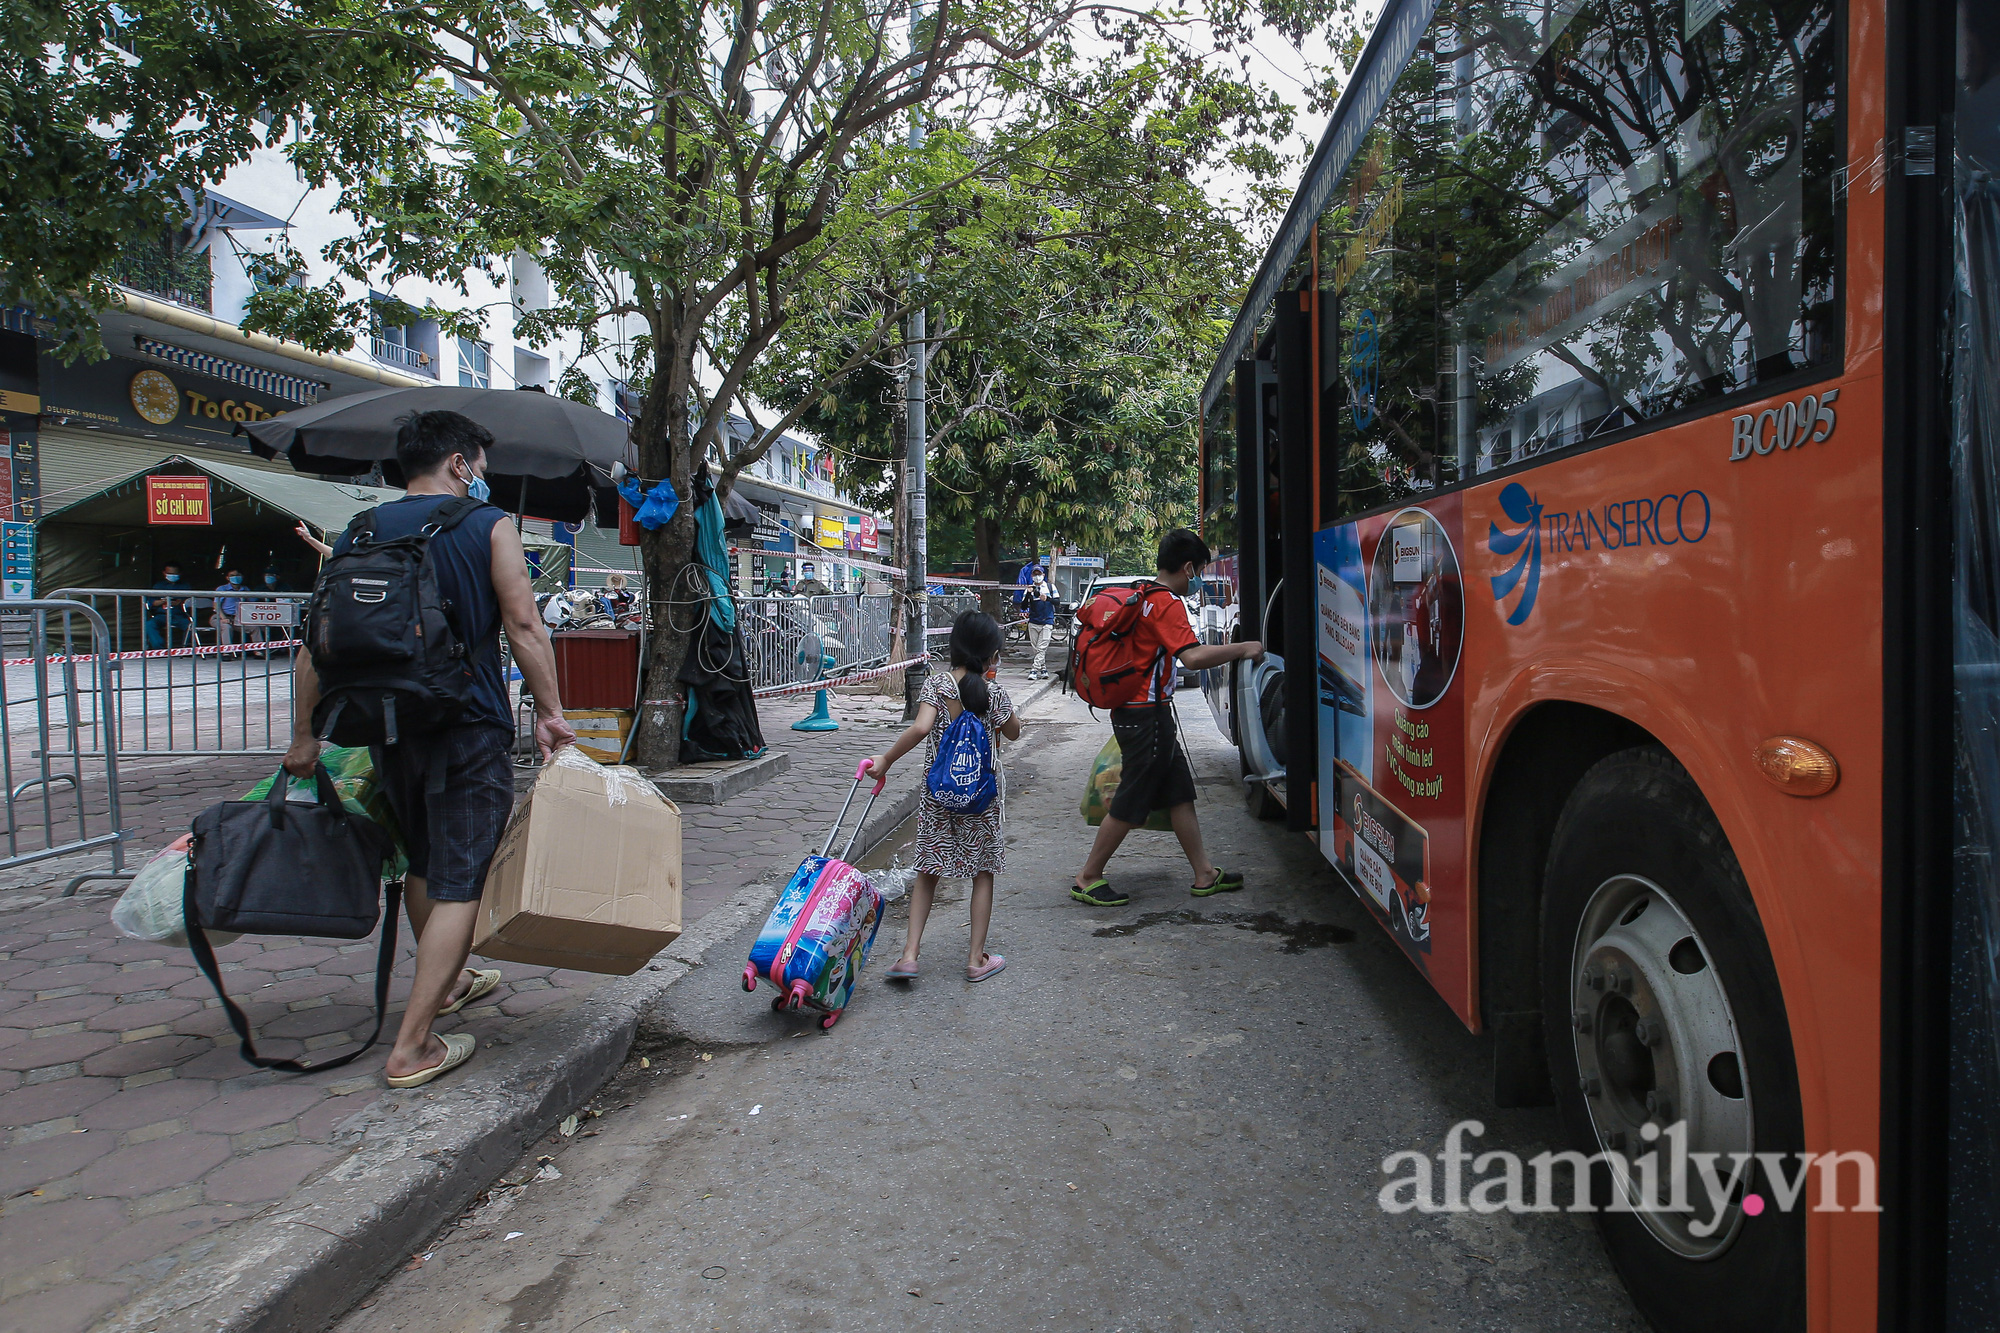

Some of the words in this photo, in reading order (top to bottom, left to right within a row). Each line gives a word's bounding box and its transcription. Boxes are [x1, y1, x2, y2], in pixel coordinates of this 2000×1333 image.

[1310, 161, 1332, 216] THANH
[1332, 120, 1354, 183] XUÂN
[1358, 74, 1377, 133] VĂN
[1379, 10, 1410, 96] QUÁN
[1729, 388, 1840, 462] BC095
[156, 493, 168, 515] SỞ
[170, 494, 184, 515] CHỈ
[186, 500, 203, 515] HUY
[1543, 489, 1711, 553] TRANSERCO
[1400, 546, 1420, 557] BIGSUN
[251, 612, 281, 621] STOP
[1395, 707, 1415, 741] Quảng
[1416, 719, 1429, 738] cáo
[1392, 733, 1405, 759] màn
[1405, 744, 1420, 767] hình
[1422, 748, 1433, 767] led
[1386, 744, 1398, 775] TVC
[1398, 765, 1415, 797] trong
[1416, 781, 1425, 796] xe
[1426, 774, 1443, 800] buýt
[1363, 810, 1395, 853] BIGSUN
[1359, 862, 1369, 880] TRÊN
[1369, 872, 1375, 887] XE
[1375, 878, 1383, 896] BUS
[1360, 848, 1373, 869] QUẢNG
[1373, 861, 1382, 878] CÁO
